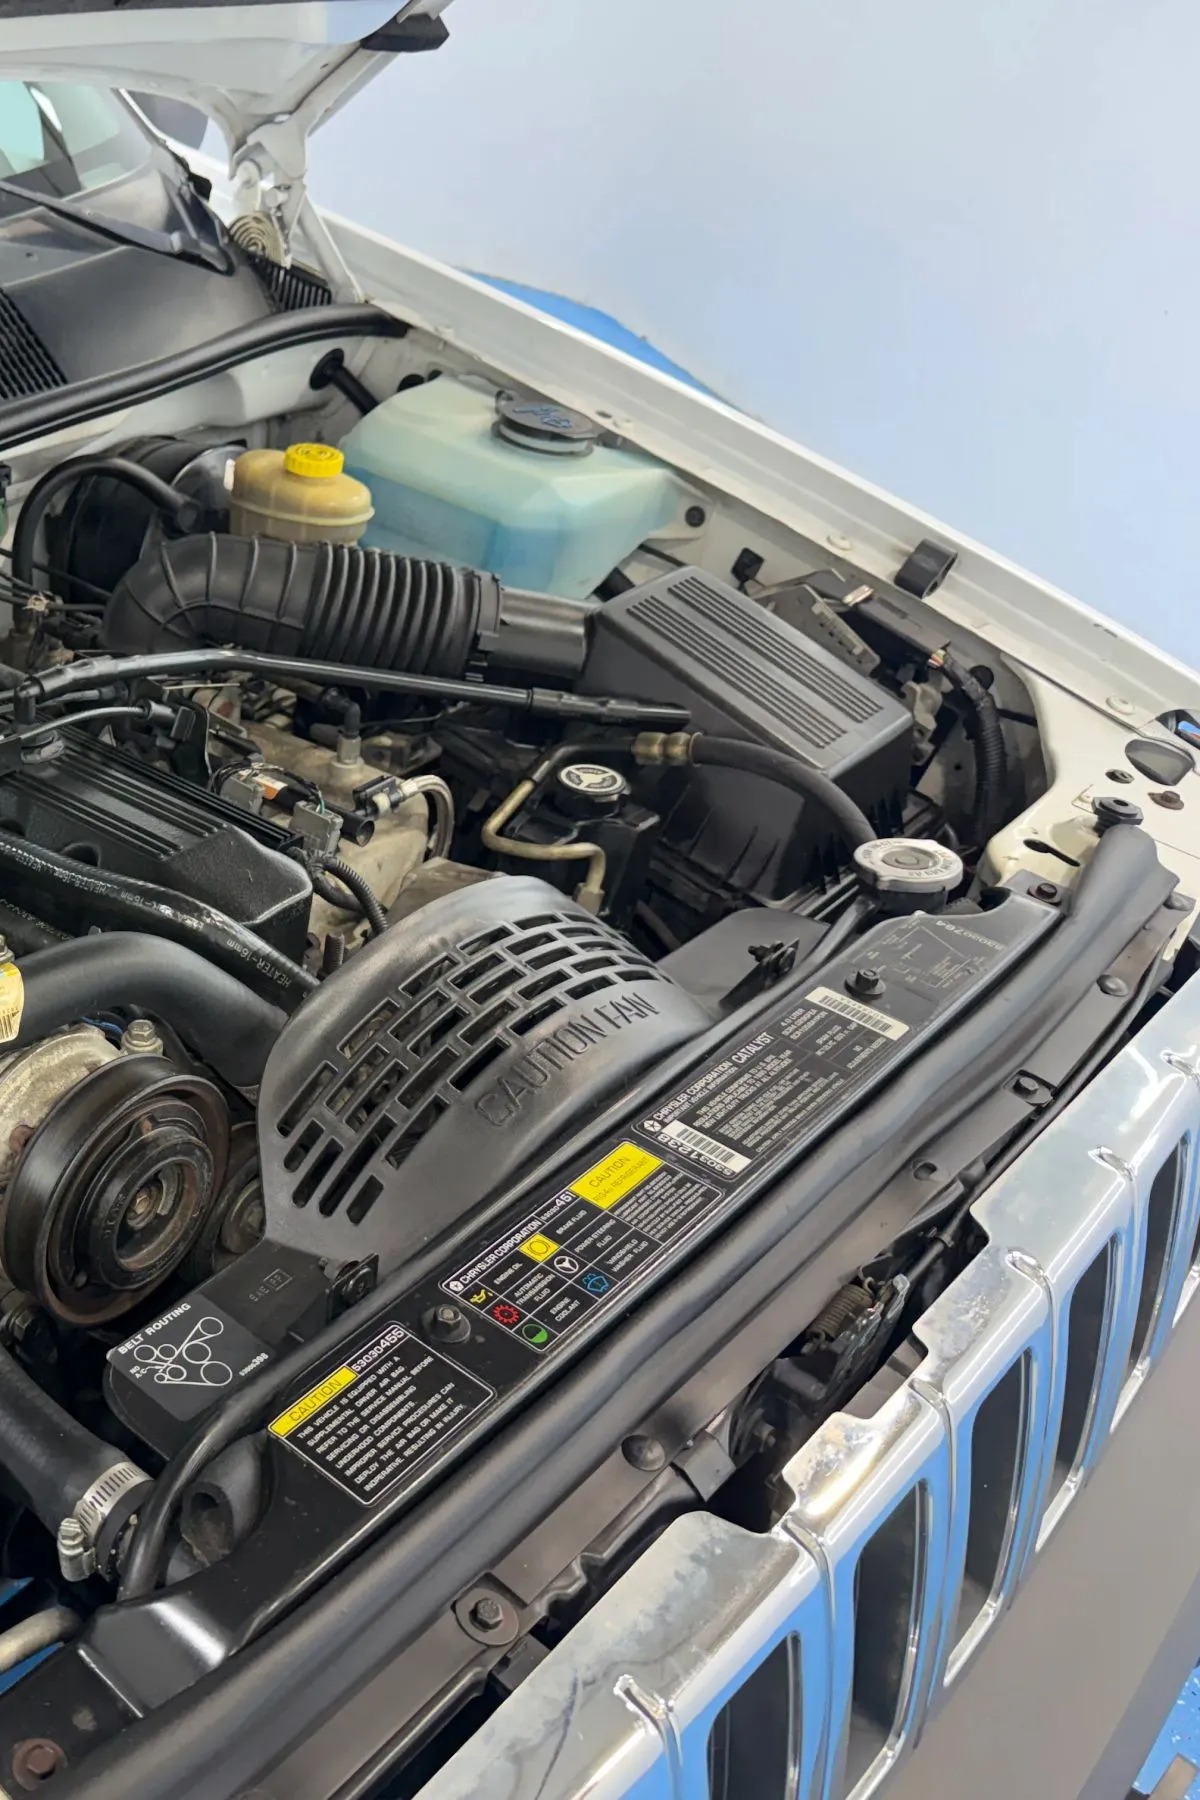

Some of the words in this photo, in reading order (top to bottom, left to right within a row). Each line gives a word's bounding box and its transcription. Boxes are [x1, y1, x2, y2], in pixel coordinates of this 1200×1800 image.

[225, 938, 293, 989] HEATER-16mm
[476, 1014, 607, 1126] CAUTION
[593, 992, 660, 1029] FAN
[729, 1031, 775, 1064] CATALYST
[652, 1092, 690, 1120] CHRYSLER
[685, 1060, 733, 1095] CORPORATION
[587, 1155, 630, 1188] CAUTION
[554, 1220, 574, 1235] BRAKE
[570, 1209, 588, 1222] FLUID
[573, 1236, 594, 1252] POWER
[591, 1218, 616, 1238] STEERING
[459, 1253, 499, 1284] CHRYSLER
[493, 1219, 542, 1257] CORPORATION
[595, 1234, 613, 1248] FLUID
[611, 1253, 634, 1272] WASHER
[632, 1240, 650, 1253] FLUID
[493, 1268, 514, 1285] ENGINE
[512, 1272, 544, 1297] AUTOMATIC
[516, 1273, 556, 1305] TRANSMISSION
[533, 1287, 551, 1302] FLUID
[549, 1296, 571, 1314] ENGINE
[553, 1299, 582, 1322] COOLANT
[117, 1333, 146, 1354] BELT
[143, 1302, 191, 1336] ROUTING
[128, 1364, 141, 1374] NO
[287, 1378, 342, 1422] CAUTION
[350, 1327, 405, 1372] 53030455
[296, 1425, 314, 1439] THIS
[312, 1404, 340, 1427] VEHICLE
[339, 1397, 349, 1405] IS
[346, 1373, 377, 1399] EQUIPPED
[375, 1360, 394, 1375] WITH
[306, 1407, 355, 1447] SUPPLEMENTAL
[354, 1388, 378, 1407] DRIVER
[377, 1377, 391, 1388] AIR
[315, 1435, 338, 1454] REFER
[337, 1426, 348, 1436] TO
[346, 1416, 361, 1428] THE
[359, 1394, 387, 1417] SERVICE
[385, 1374, 412, 1396] MANUAL
[409, 1355, 434, 1376] BEFORE
[325, 1433, 360, 1461] SERVICING
[358, 1424, 370, 1434] OR
[368, 1384, 417, 1425] DISASSEMBLING
[344, 1448, 378, 1476] IMPROPER
[376, 1426, 404, 1448] SERVICE
[402, 1393, 442, 1427] PROCEDURES
[439, 1381, 455, 1395] CAN
[403, 1428, 437, 1457] RESULTING
[434, 1421, 444, 1429] IN
[335, 1436, 374, 1469] UNDERHOOD
[354, 1462, 380, 1484] DEPLOY
[380, 1449, 395, 1461] THE
[394, 1438, 407, 1449] AIR
[406, 1425, 422, 1439] BAG
[419, 1417, 431, 1427] OR
[429, 1402, 448, 1419] MAKE
